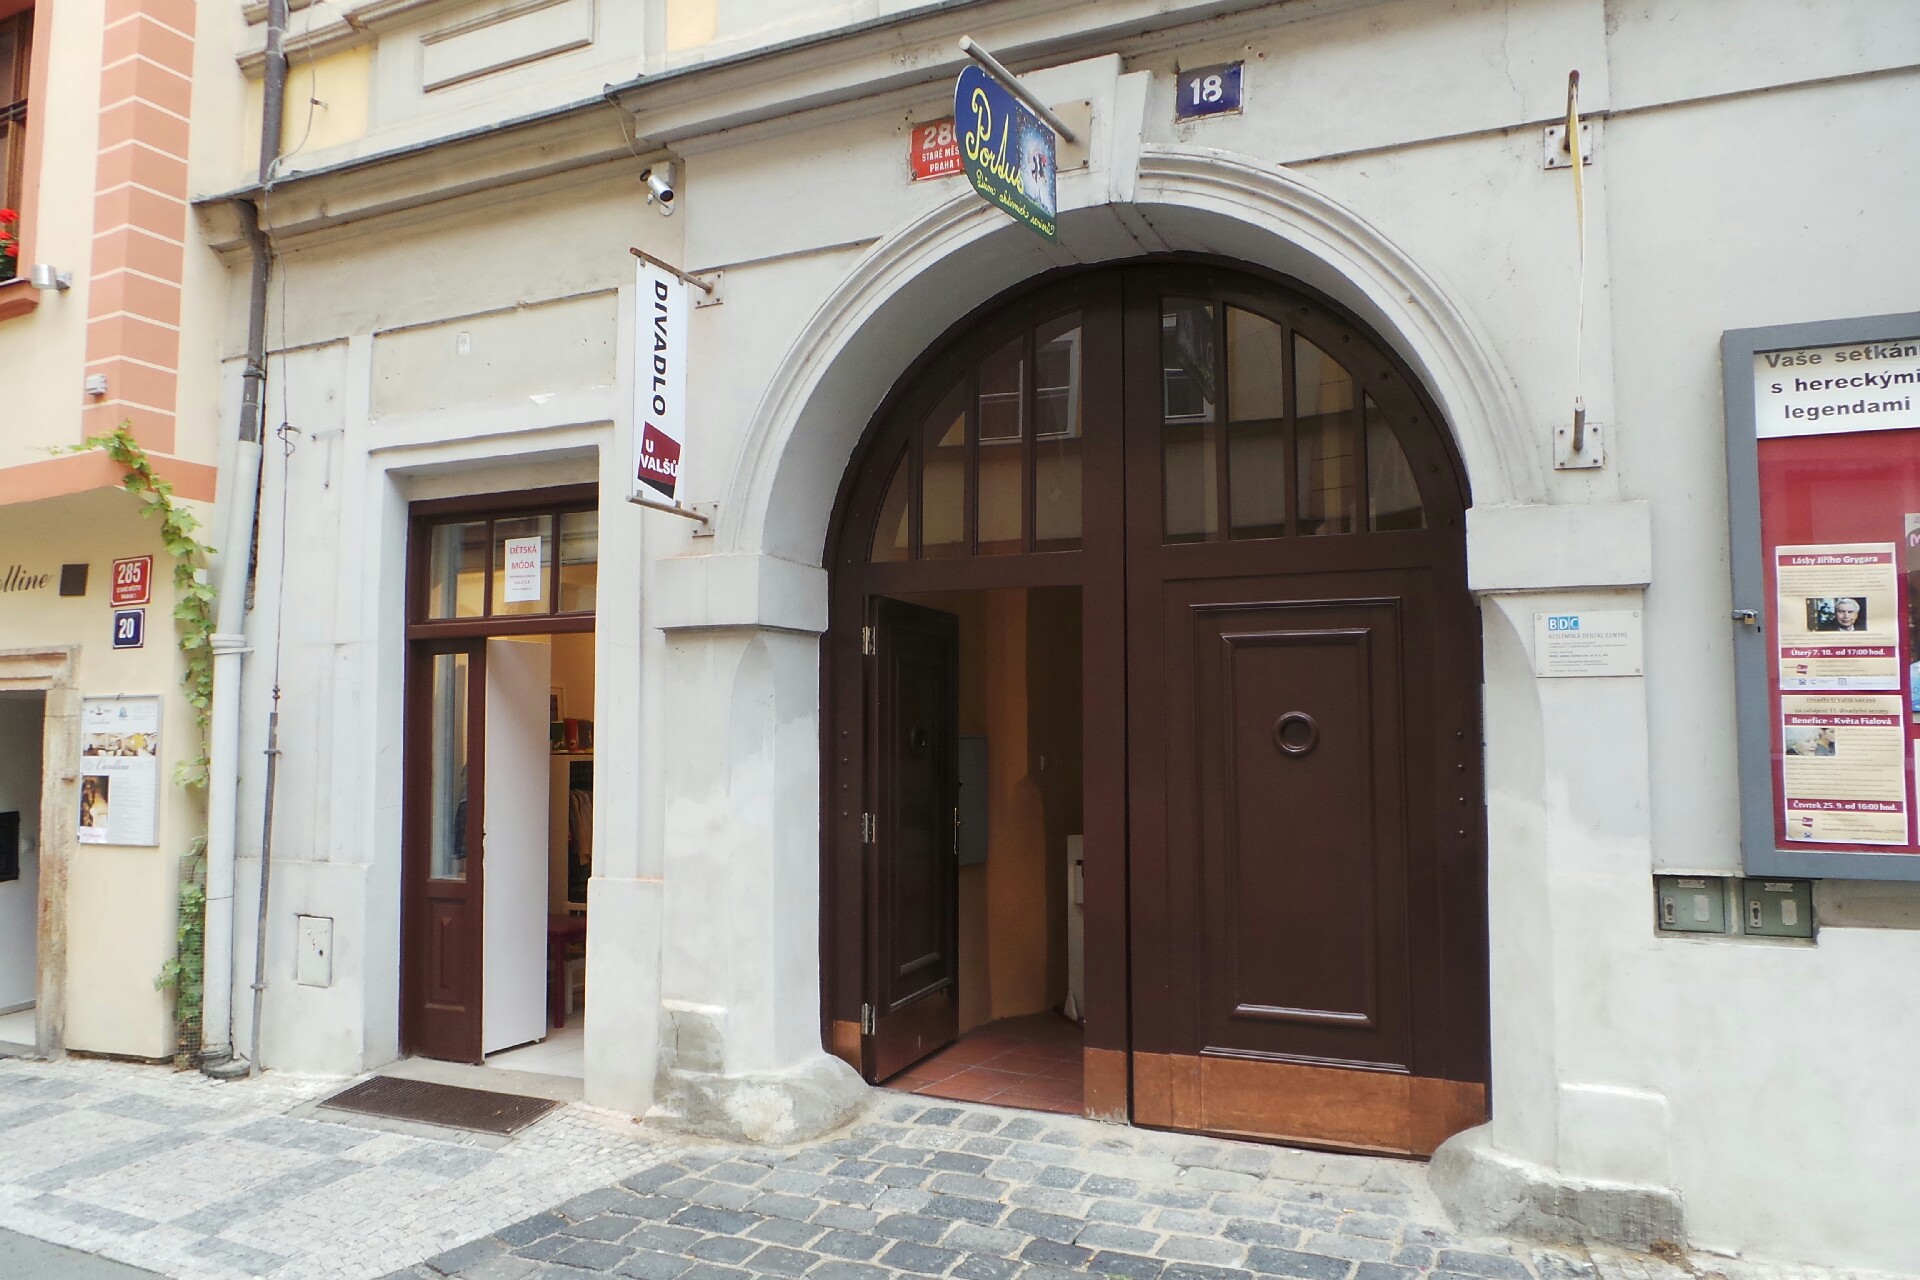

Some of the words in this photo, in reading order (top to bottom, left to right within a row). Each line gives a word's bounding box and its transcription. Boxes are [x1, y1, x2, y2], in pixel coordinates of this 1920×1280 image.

[1190, 75, 1222, 105] 18
[922, 147, 943, 162] STARÉ
[945, 144, 959, 157] MĚS
[930, 158, 954, 173] PRAHA
[652, 280, 668, 416] DIVADLO
[1765, 351, 1822, 368] Vaše
[1835, 342, 1920, 363] setkán
[1771, 383, 1783, 394] s
[1795, 368, 1920, 392] hereckými
[1785, 396, 1911, 421] legendami
[645, 439, 654, 453] U
[640, 453, 679, 478] VALŠŮ
[509, 544, 537, 555] DĚTSKÁ
[511, 560, 535, 570] MÓDA
[1792, 557, 1816, 565] Lásky
[1843, 555, 1878, 564] Grygara
[117, 562, 141, 584] 285
[118, 617, 135, 639] 20
[1549, 617, 1578, 630] BDC
[1791, 648, 1812, 658] Úterý
[1868, 648, 1886, 656] hod.
[1792, 716, 1828, 724] Benefice
[1834, 716, 1860, 725] Květa
[1861, 717, 1892, 725] Fialová
[1793, 800, 1822, 809] Čtvrtek
[1845, 802, 1856, 810] od
[1879, 803, 1898, 811] hod.
